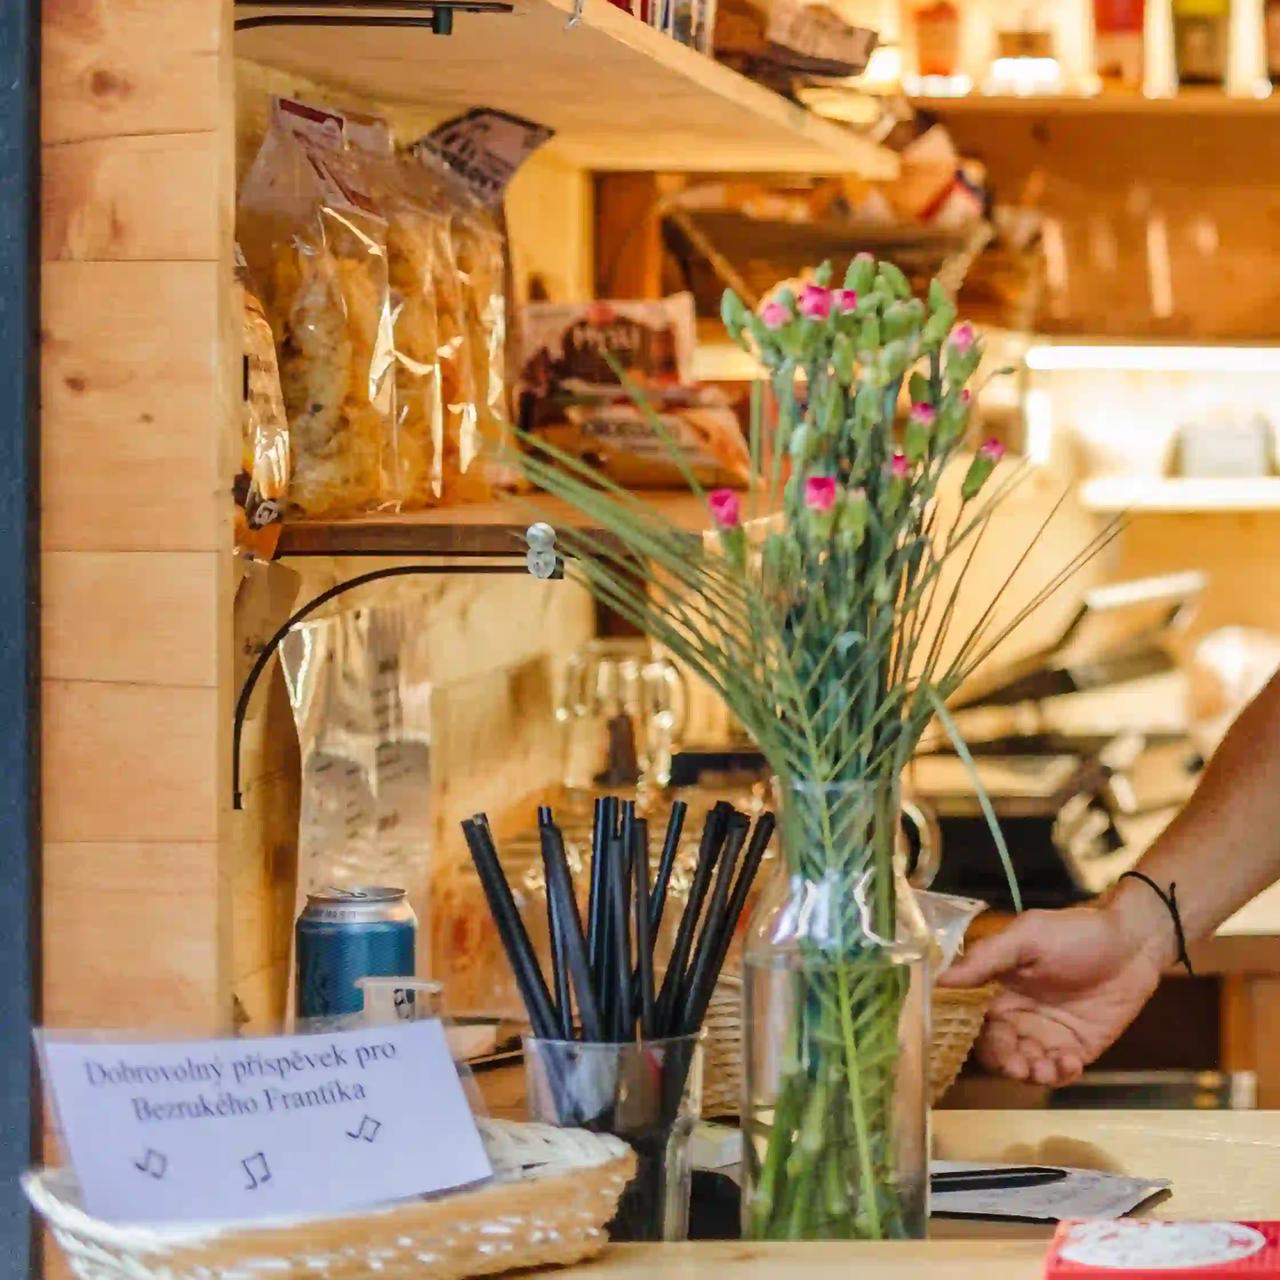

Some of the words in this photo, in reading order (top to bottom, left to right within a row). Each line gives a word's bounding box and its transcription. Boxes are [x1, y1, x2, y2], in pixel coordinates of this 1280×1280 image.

[84, 1056, 223, 1087] Dobrovolný
[233, 1043, 348, 1083] příspěvek
[354, 1041, 396, 1068] pro
[131, 1091, 258, 1121] Bezrukého
